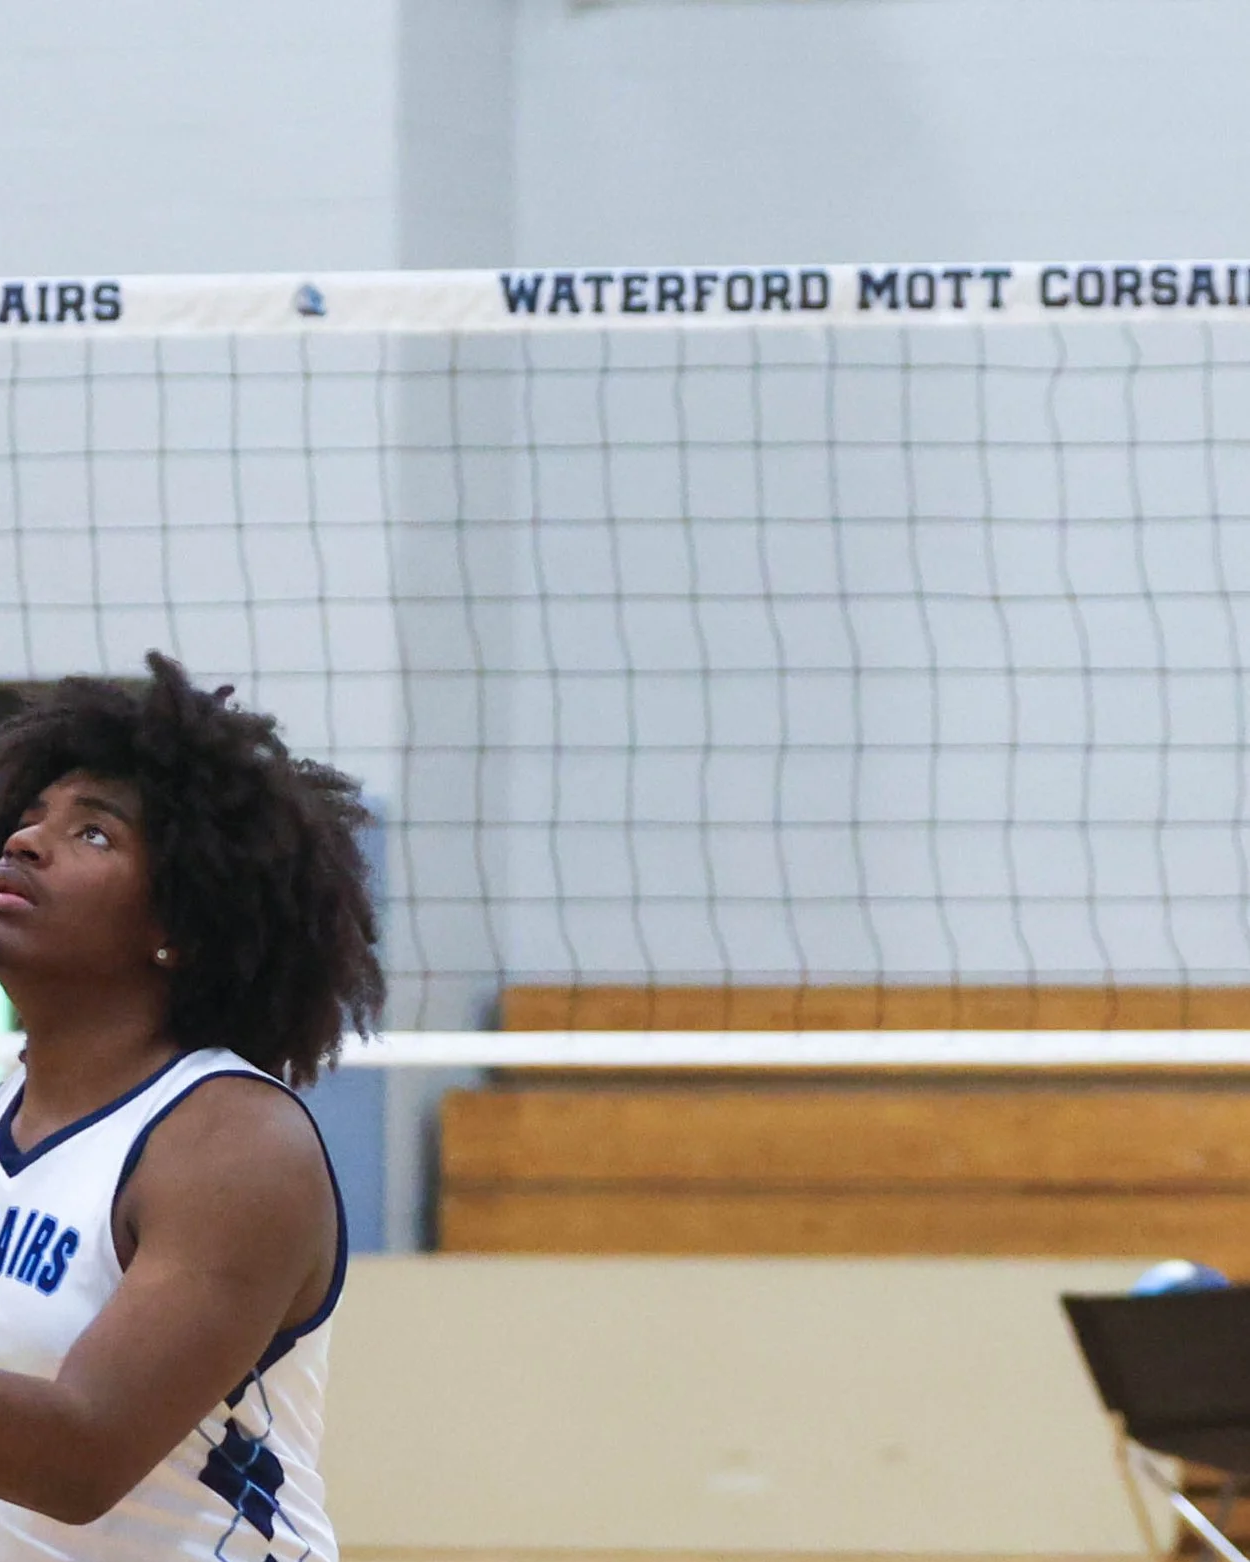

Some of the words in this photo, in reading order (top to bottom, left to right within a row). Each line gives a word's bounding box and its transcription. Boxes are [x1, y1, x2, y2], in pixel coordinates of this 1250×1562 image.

[501, 269, 829, 315] WATERFORD
[858, 268, 1012, 310] MOTT
[1040, 265, 1250, 308] CORSAI
